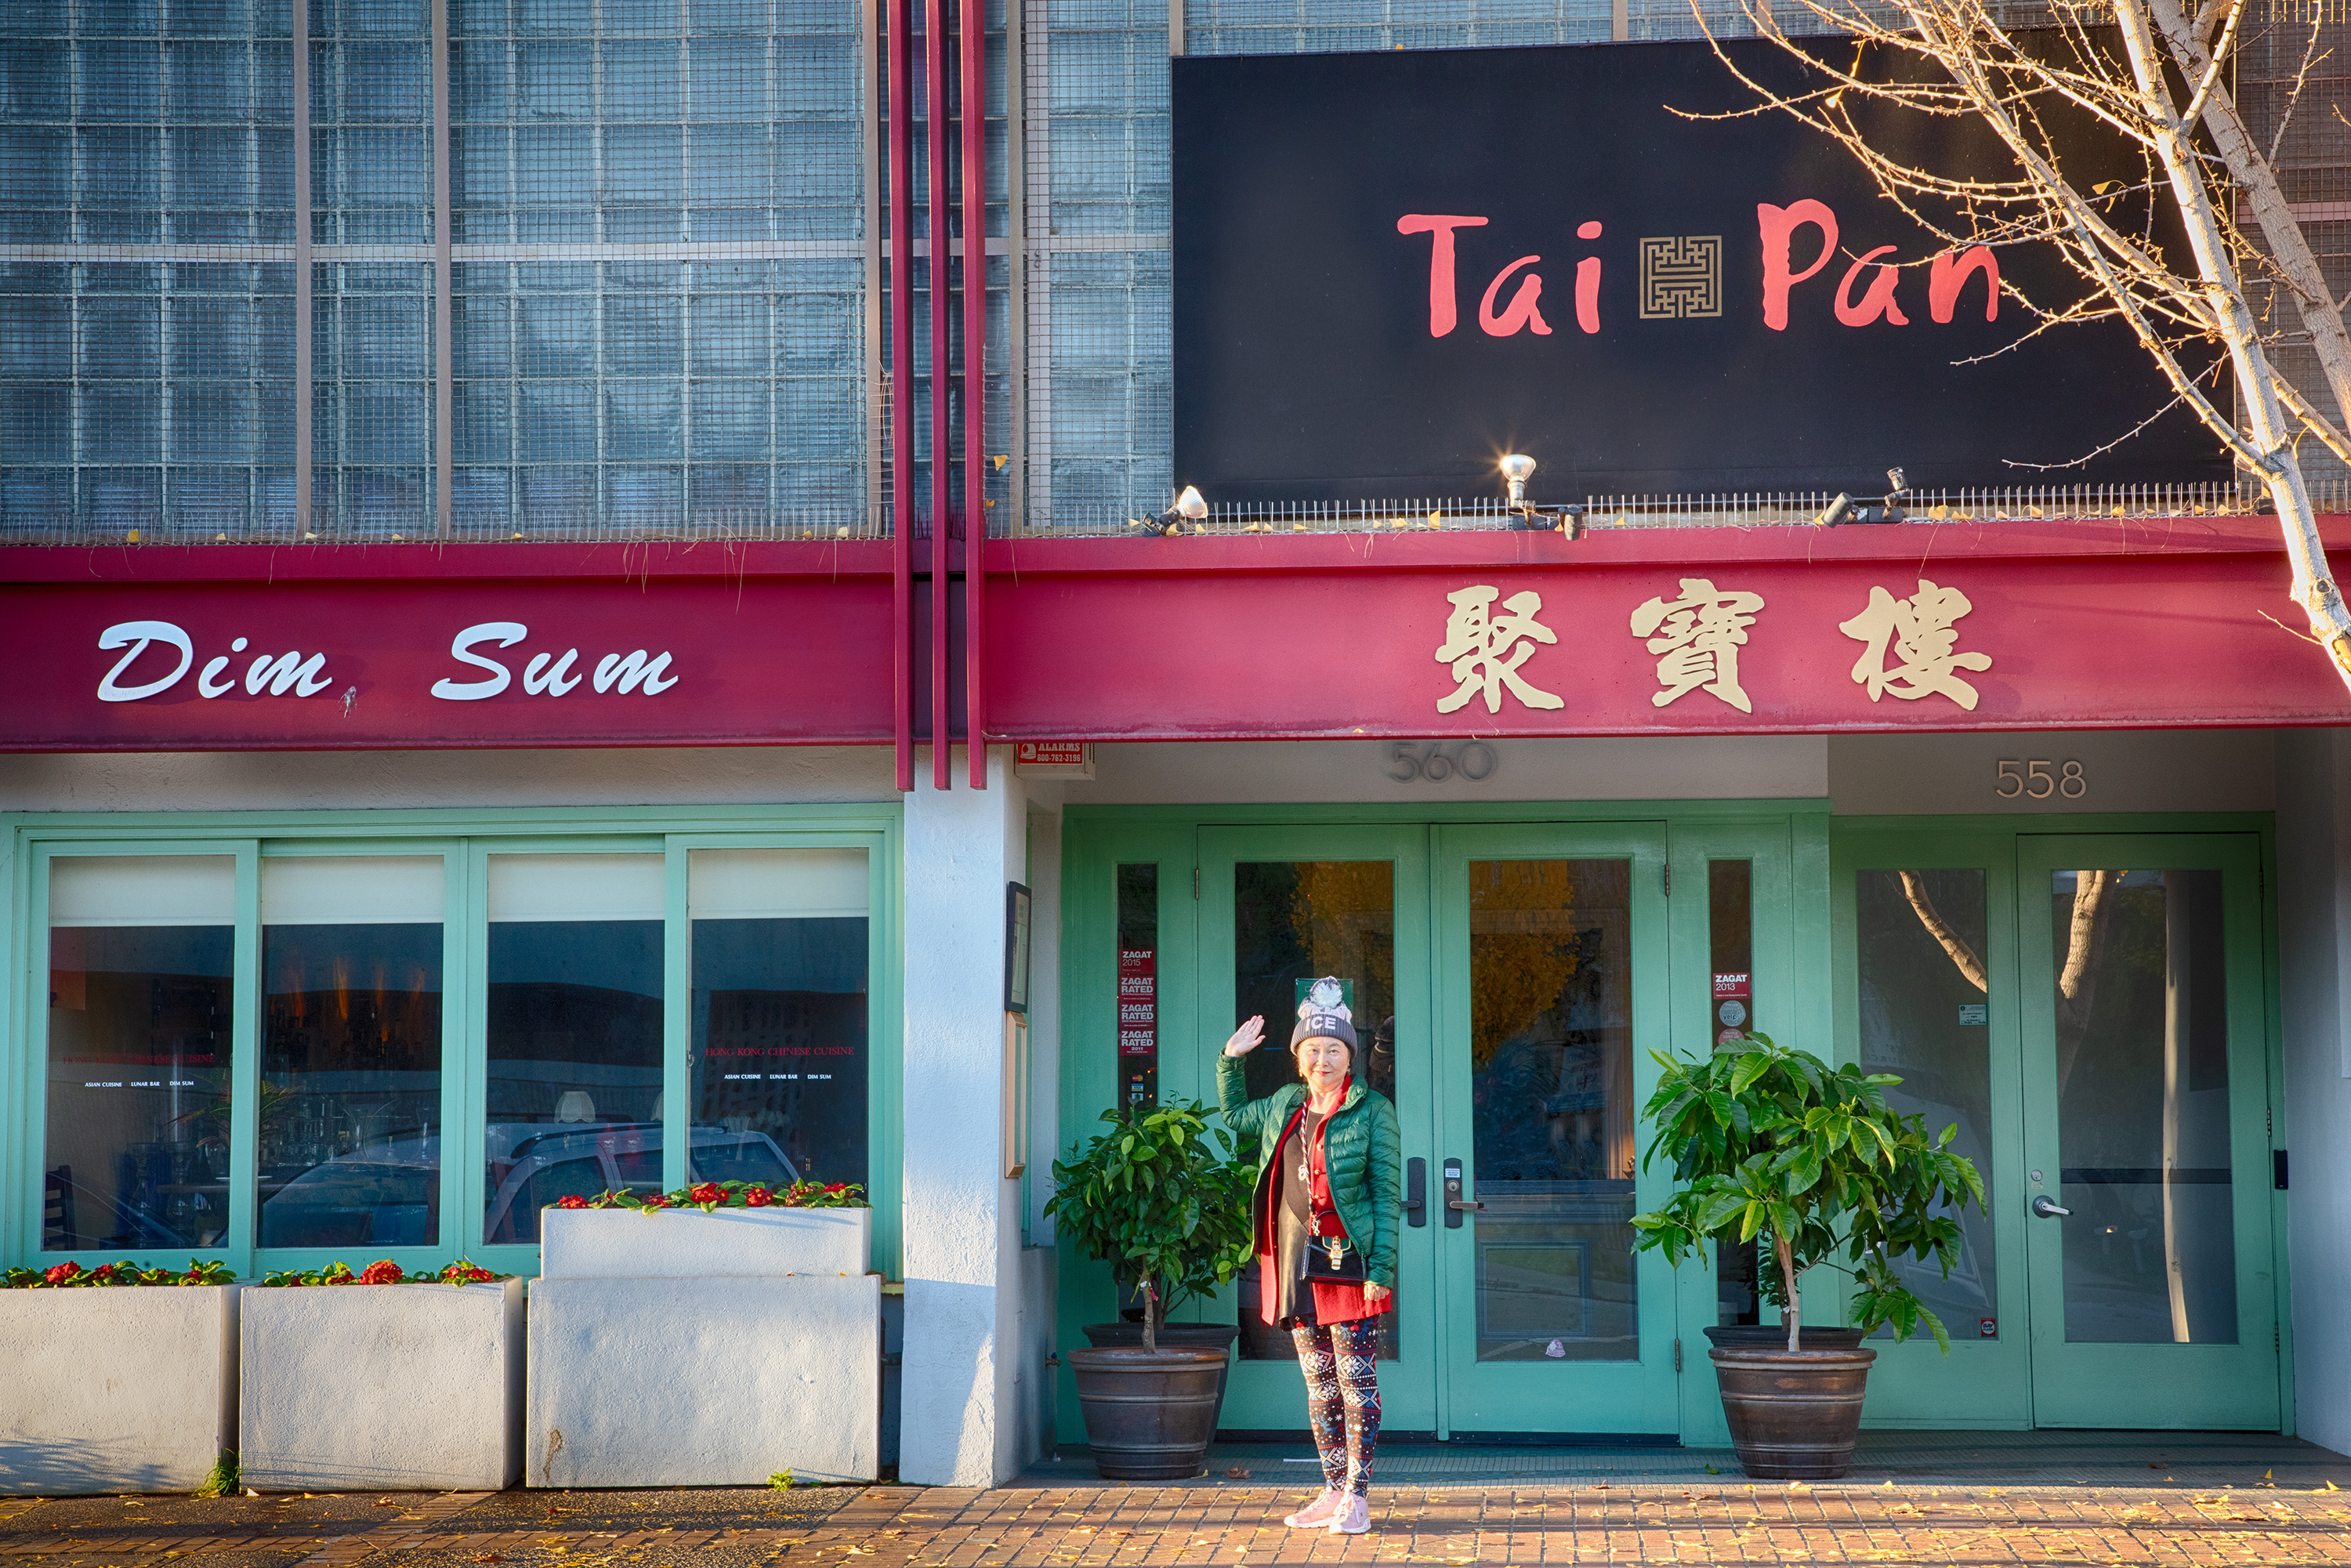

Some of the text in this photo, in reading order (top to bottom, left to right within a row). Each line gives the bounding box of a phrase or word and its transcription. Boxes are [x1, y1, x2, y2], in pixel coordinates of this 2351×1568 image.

[1397, 198, 2000, 338] Tai Pan
[1435, 578, 1993, 715] 聚寶樓
[98, 620, 679, 702] Dim Sum
[1038, 743, 1081, 751] ALARMS
[1389, 742, 1498, 784] 560
[1996, 761, 2086, 798] 558
[1715, 974, 1748, 983] ZAGAT
[1715, 983, 1736, 991] 2013
[1305, 1016, 1336, 1032] ICE
[705, 1047, 855, 1056] HONG KONG CHINESE CUISINE
